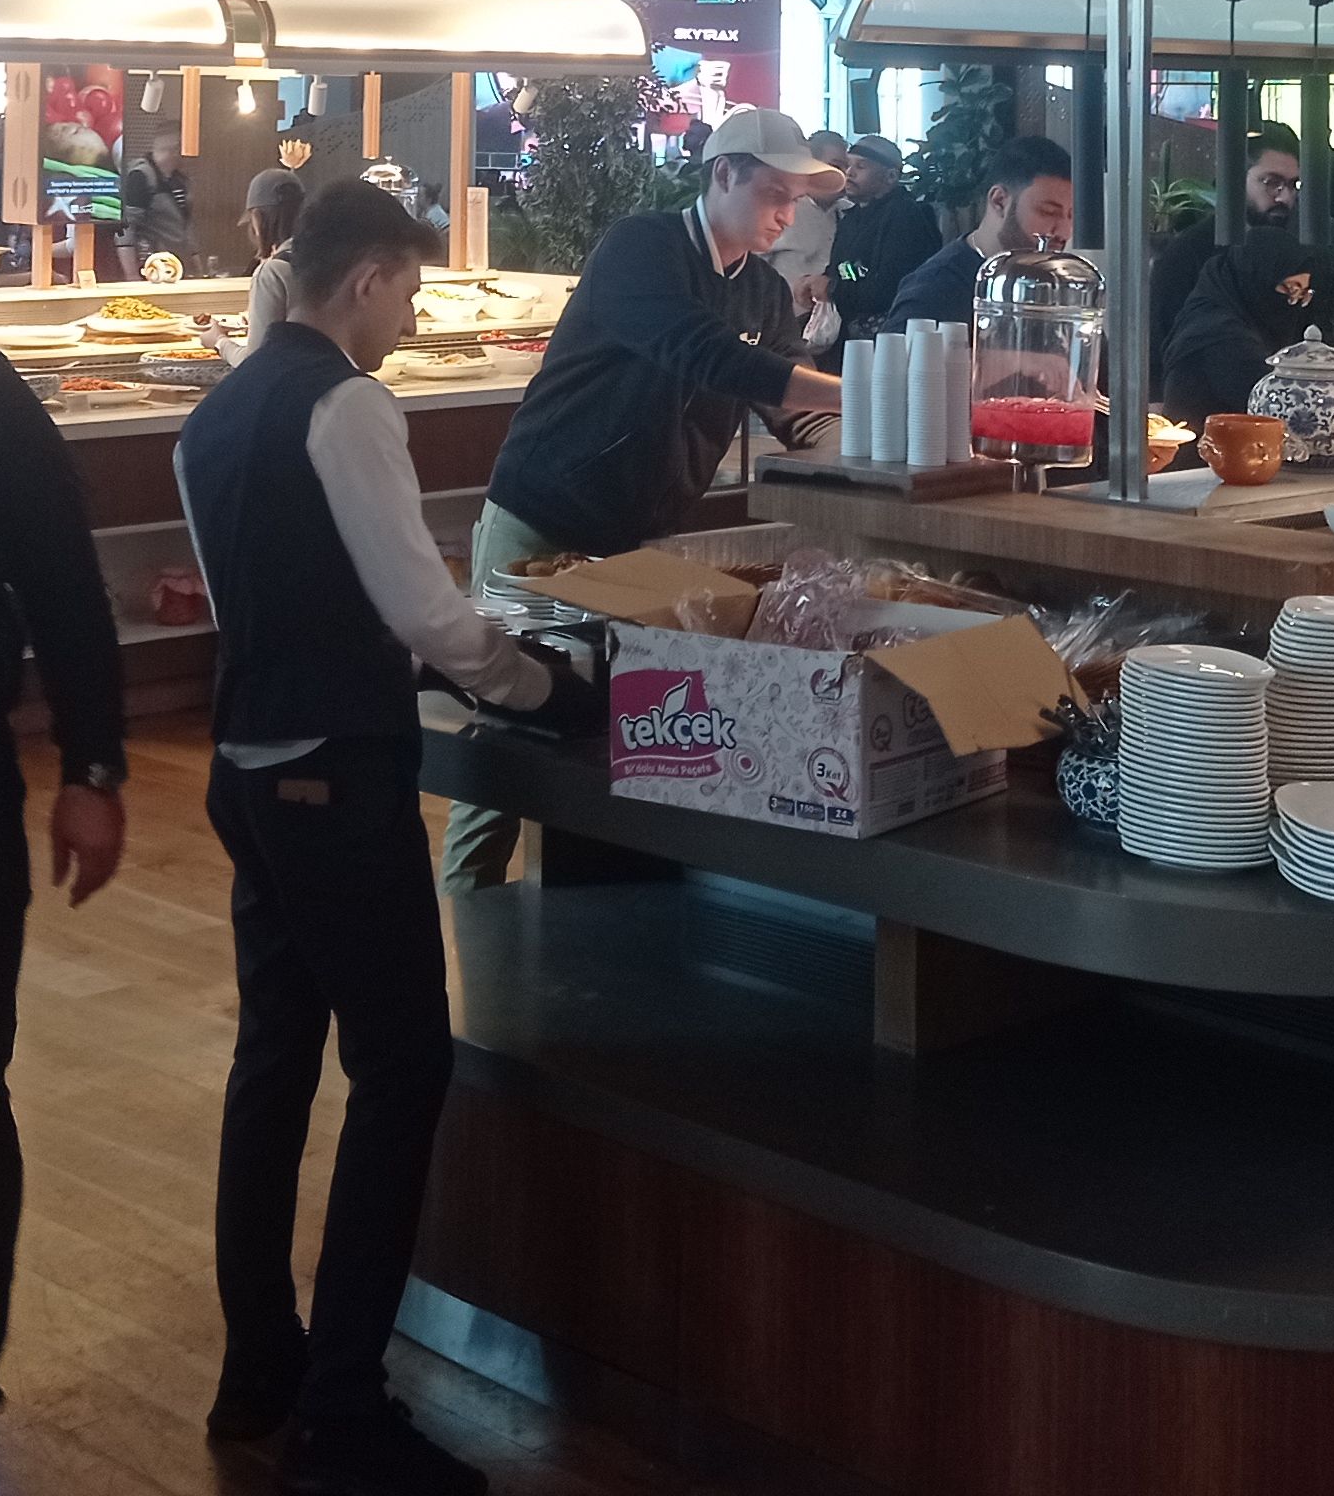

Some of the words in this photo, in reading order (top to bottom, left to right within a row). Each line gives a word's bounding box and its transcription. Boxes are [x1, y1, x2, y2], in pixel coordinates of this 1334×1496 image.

[674, 27, 739, 41] SKYTRAX
[619, 706, 737, 751] tekçek
[681, 764, 711, 777] Peçete
[816, 763, 826, 777] 3
[836, 809, 847, 819] 24
